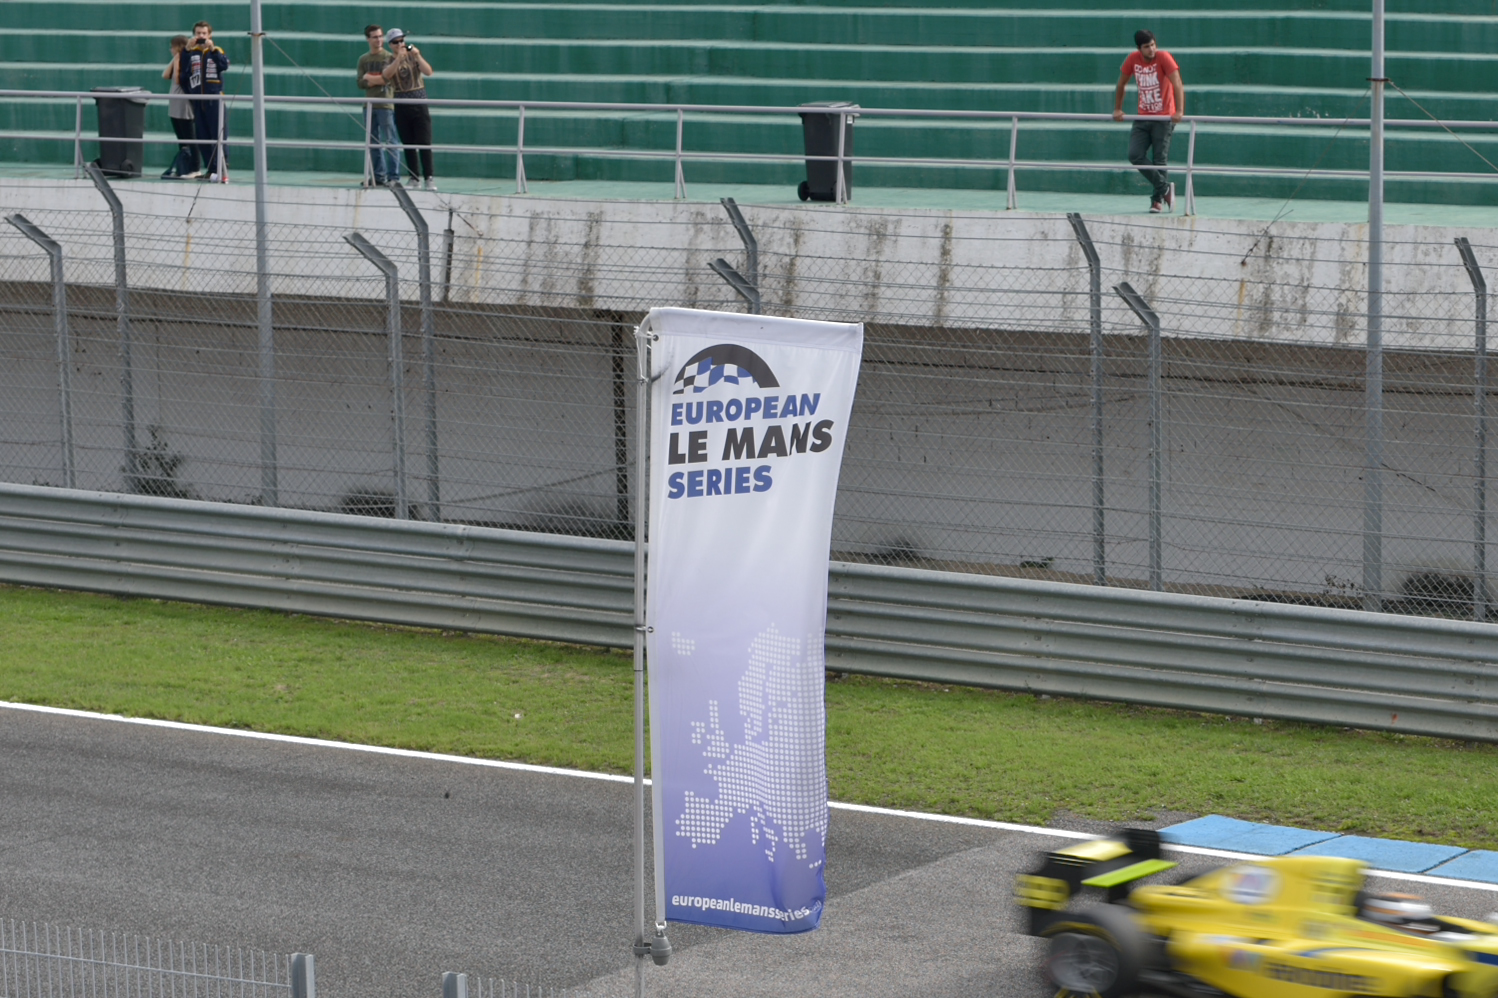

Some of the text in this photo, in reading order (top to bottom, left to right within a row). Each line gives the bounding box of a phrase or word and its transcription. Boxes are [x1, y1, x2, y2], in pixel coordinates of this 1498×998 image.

[1139, 88, 1163, 104] AKE
[671, 393, 821, 426] EUROPEAN
[668, 419, 834, 465] LE MANS
[667, 465, 773, 499] SERIES
